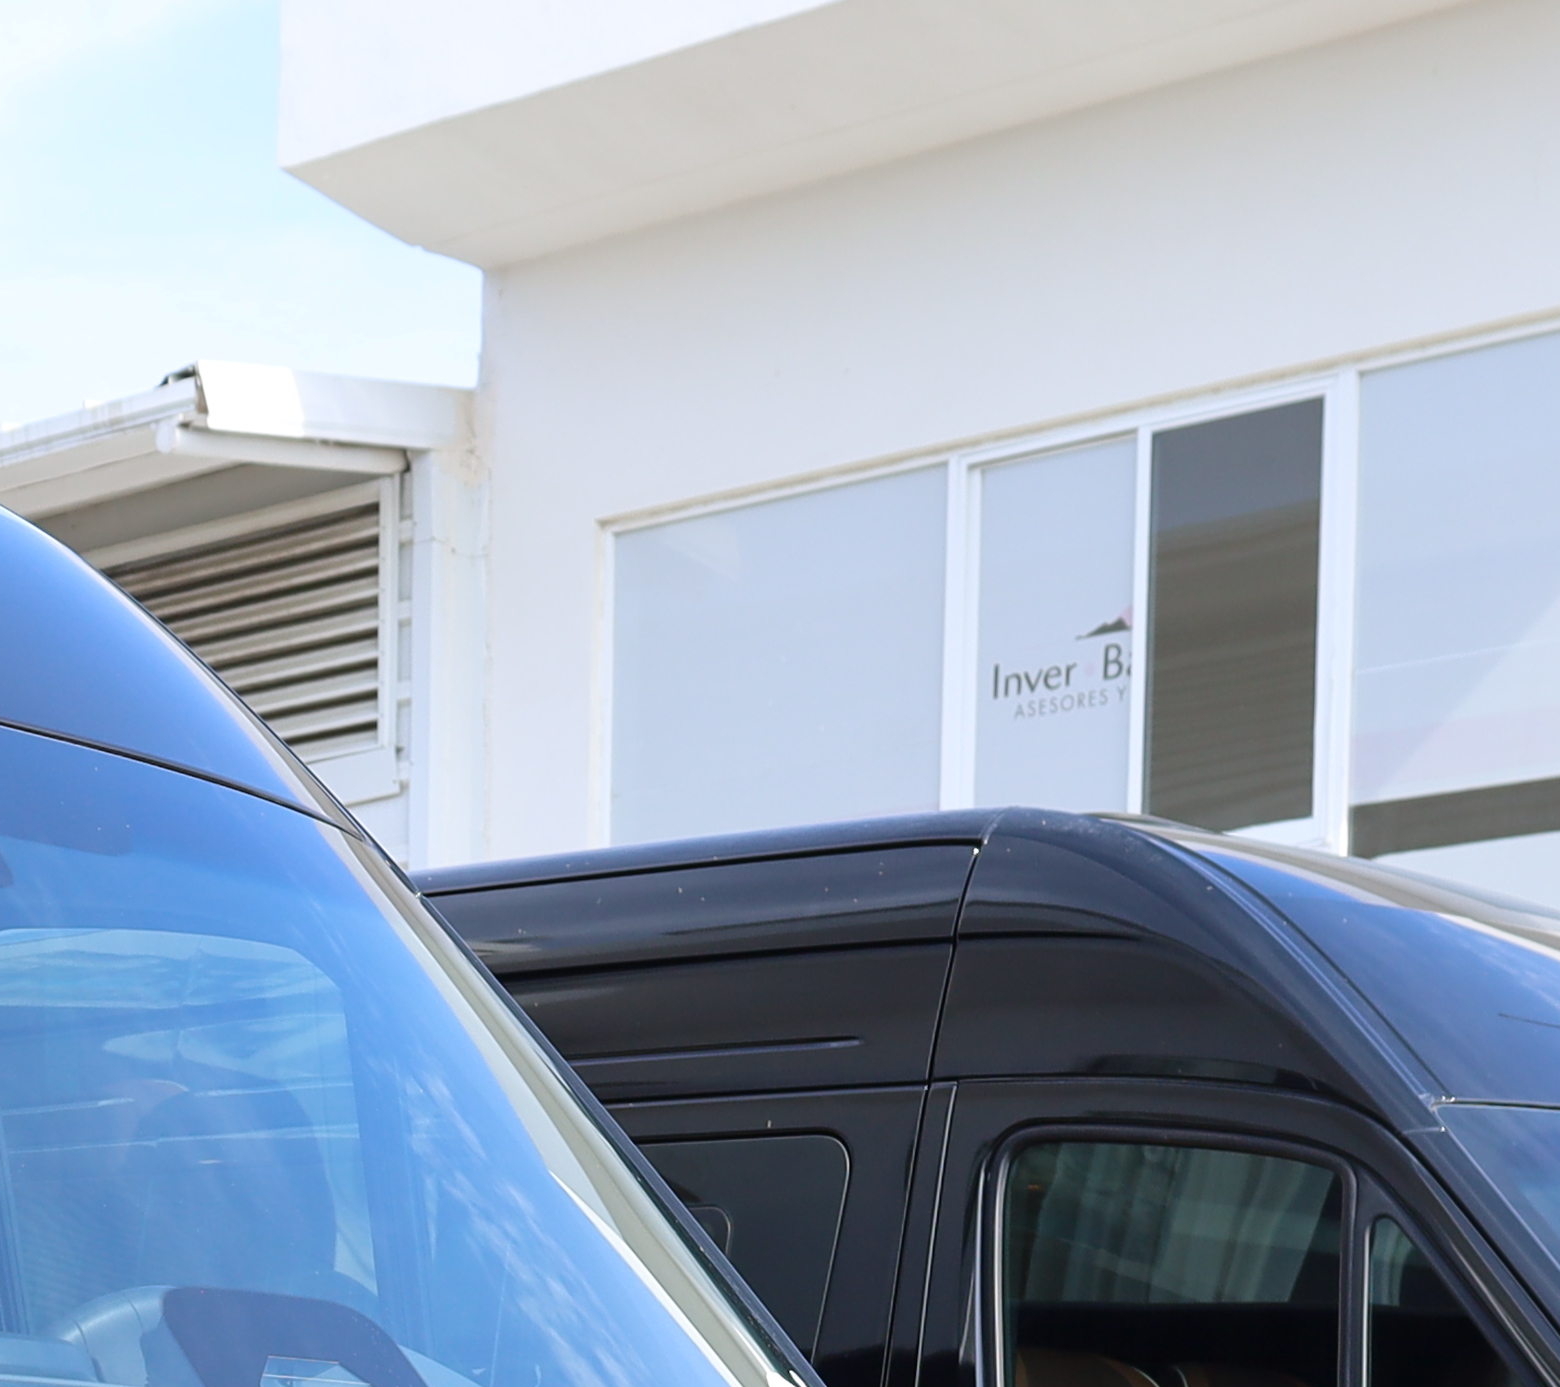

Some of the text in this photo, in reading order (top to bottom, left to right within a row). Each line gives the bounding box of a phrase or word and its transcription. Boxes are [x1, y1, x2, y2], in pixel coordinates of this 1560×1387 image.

[992, 661, 1078, 700] Inver
[1013, 685, 1128, 721] ASESORES Y
